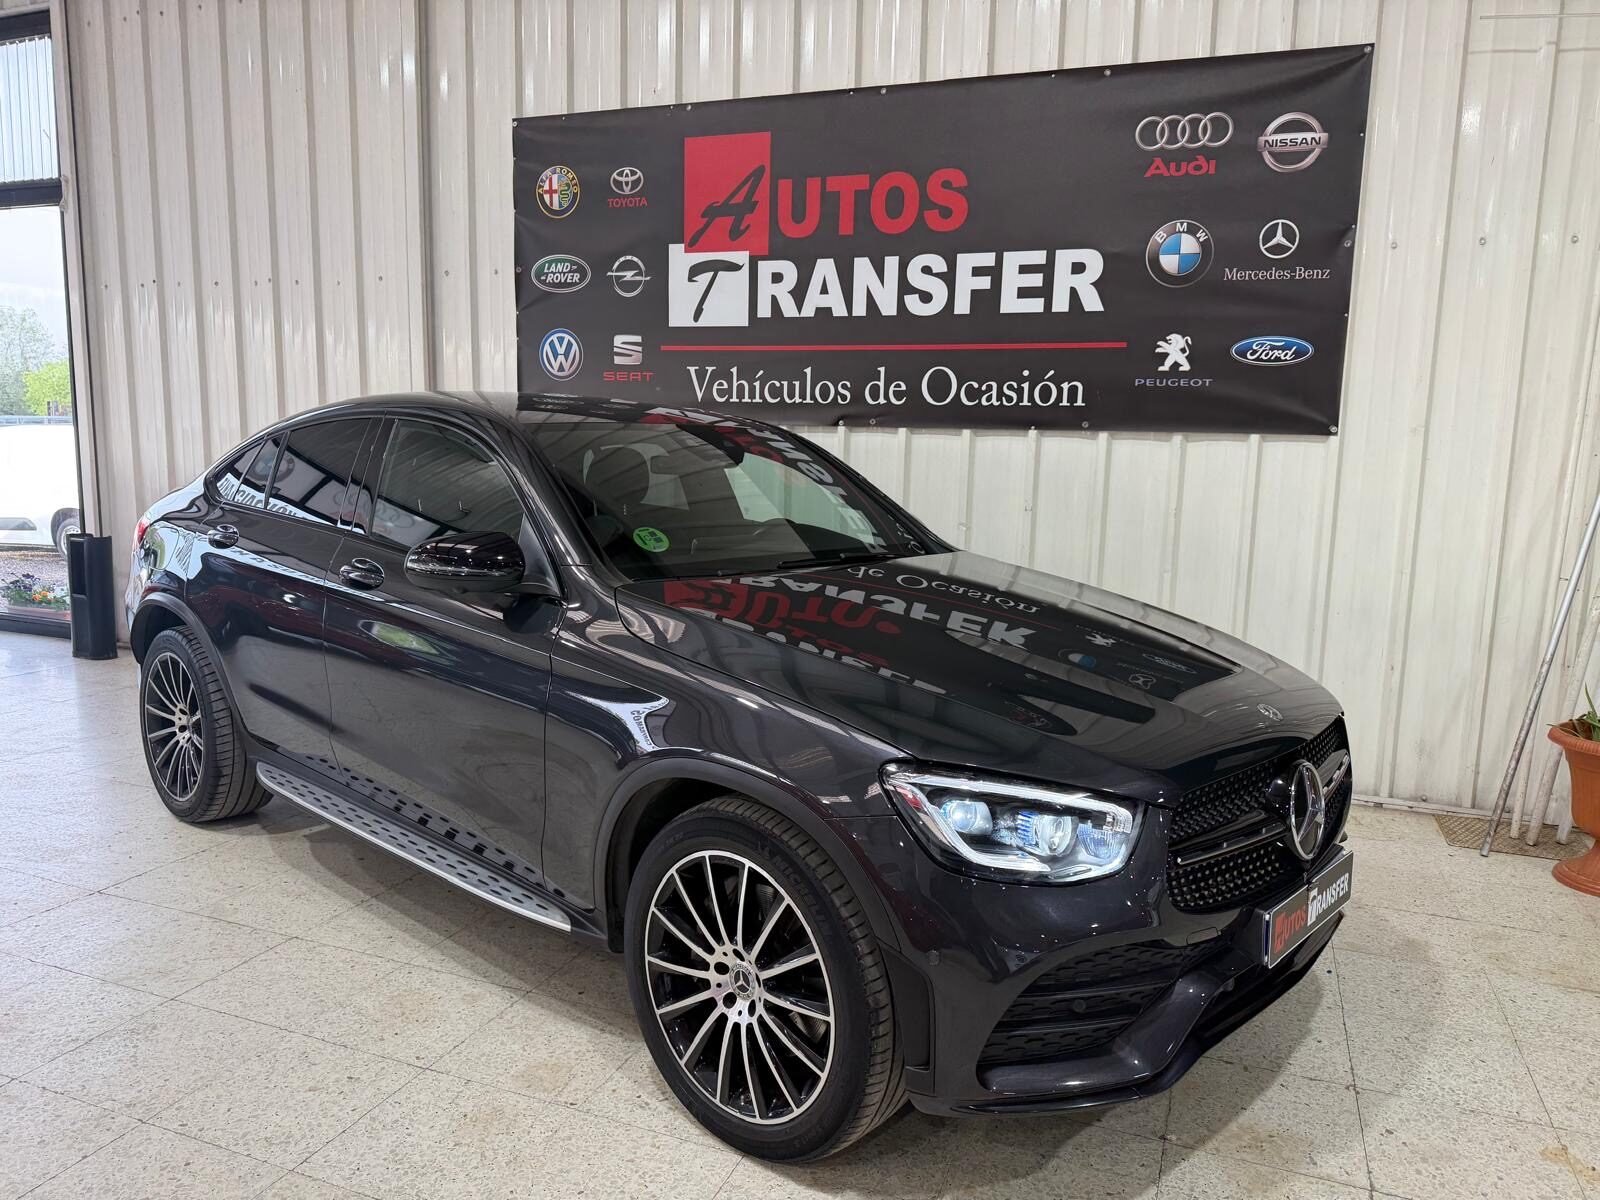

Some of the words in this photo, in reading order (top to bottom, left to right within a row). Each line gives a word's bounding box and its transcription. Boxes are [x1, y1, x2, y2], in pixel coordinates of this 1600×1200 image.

[1263, 136, 1322, 149] NISSAN
[1143, 155, 1217, 178] Audi
[607, 197, 648, 208] TOYOTA
[688, 164, 969, 248] AUTOS
[1154, 222, 1209, 244] BMW
[1223, 266, 1331, 281] Mercedes-Benz
[687, 248, 1105, 323] TRANSFER
[1246, 340, 1297, 361] Ford
[603, 371, 653, 382] SEAT
[687, 365, 852, 407] Vehículos
[864, 366, 907, 406] de
[921, 365, 1086, 407] Ocasión
[1134, 378, 1213, 387] PEUGEOT
[1274, 905, 1307, 953] AUTOS
[1308, 872, 1349, 925] TRANSFER
